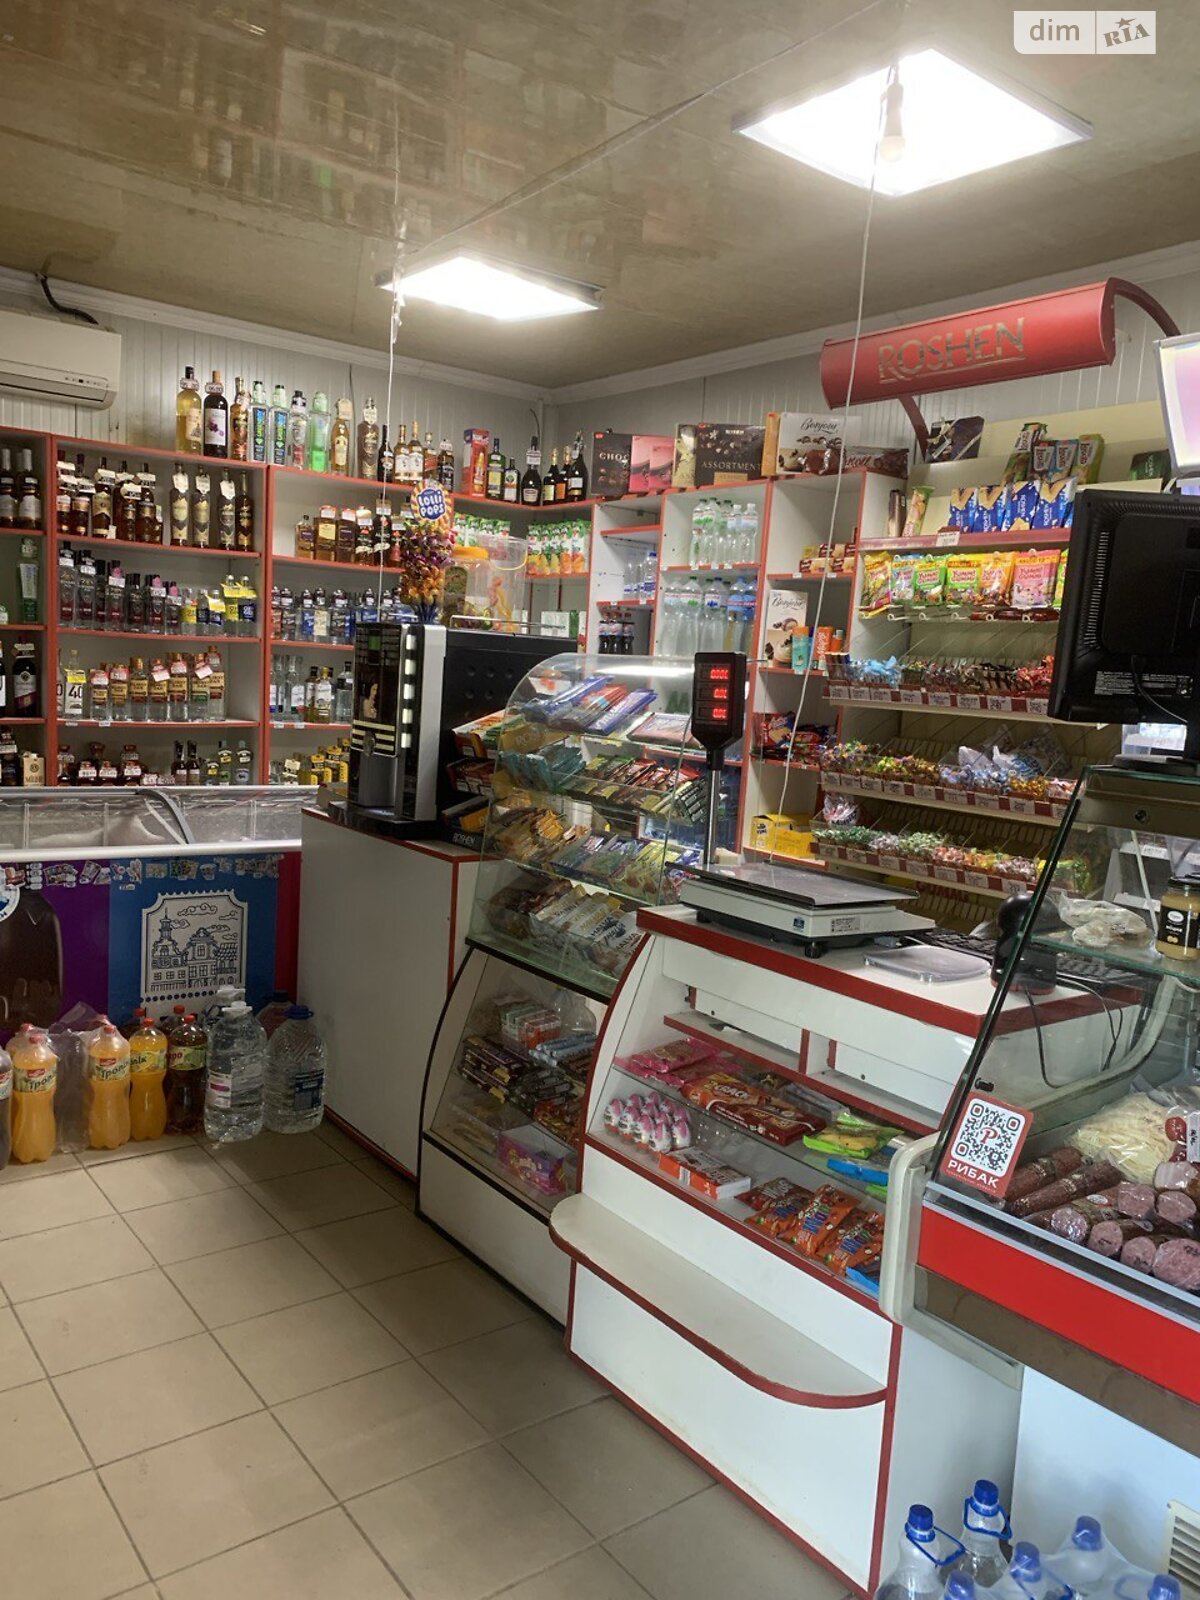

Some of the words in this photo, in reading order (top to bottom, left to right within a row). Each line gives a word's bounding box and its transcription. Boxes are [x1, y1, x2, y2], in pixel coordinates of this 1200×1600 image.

[878, 318, 1025, 383] ROSHEN
[420, 504, 445, 517] POPS
[947, 1159, 999, 1188] РИБАК
